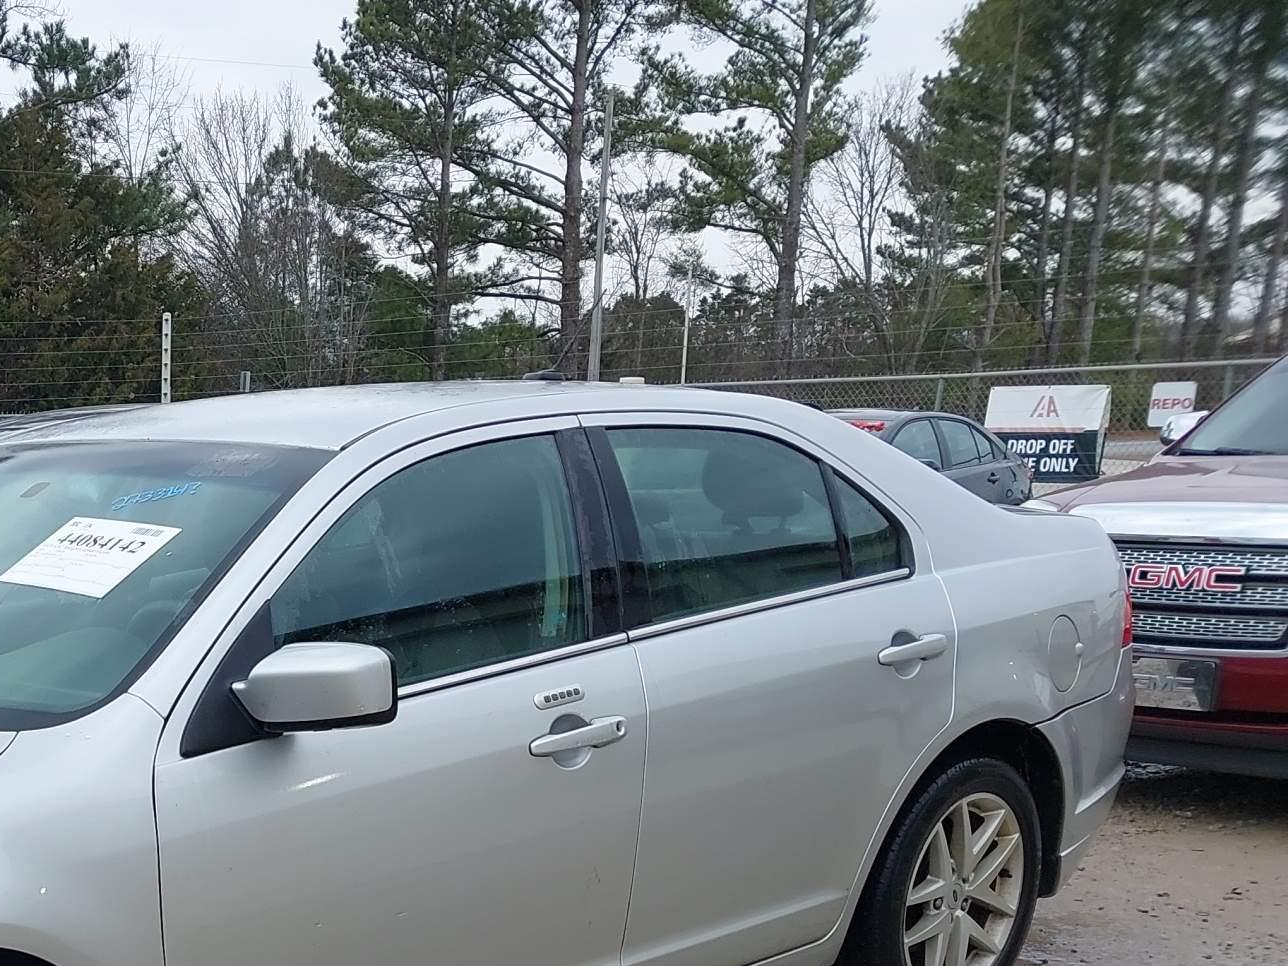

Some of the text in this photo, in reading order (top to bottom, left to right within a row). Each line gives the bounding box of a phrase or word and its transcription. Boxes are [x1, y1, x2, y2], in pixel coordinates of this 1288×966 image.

[1152, 398, 1193, 410] REPO
[1007, 439, 1075, 454] DROP OFF
[1039, 457, 1079, 473] ONLY
[57, 533, 146, 554] 44084142
[1130, 563, 1245, 591] GMC
